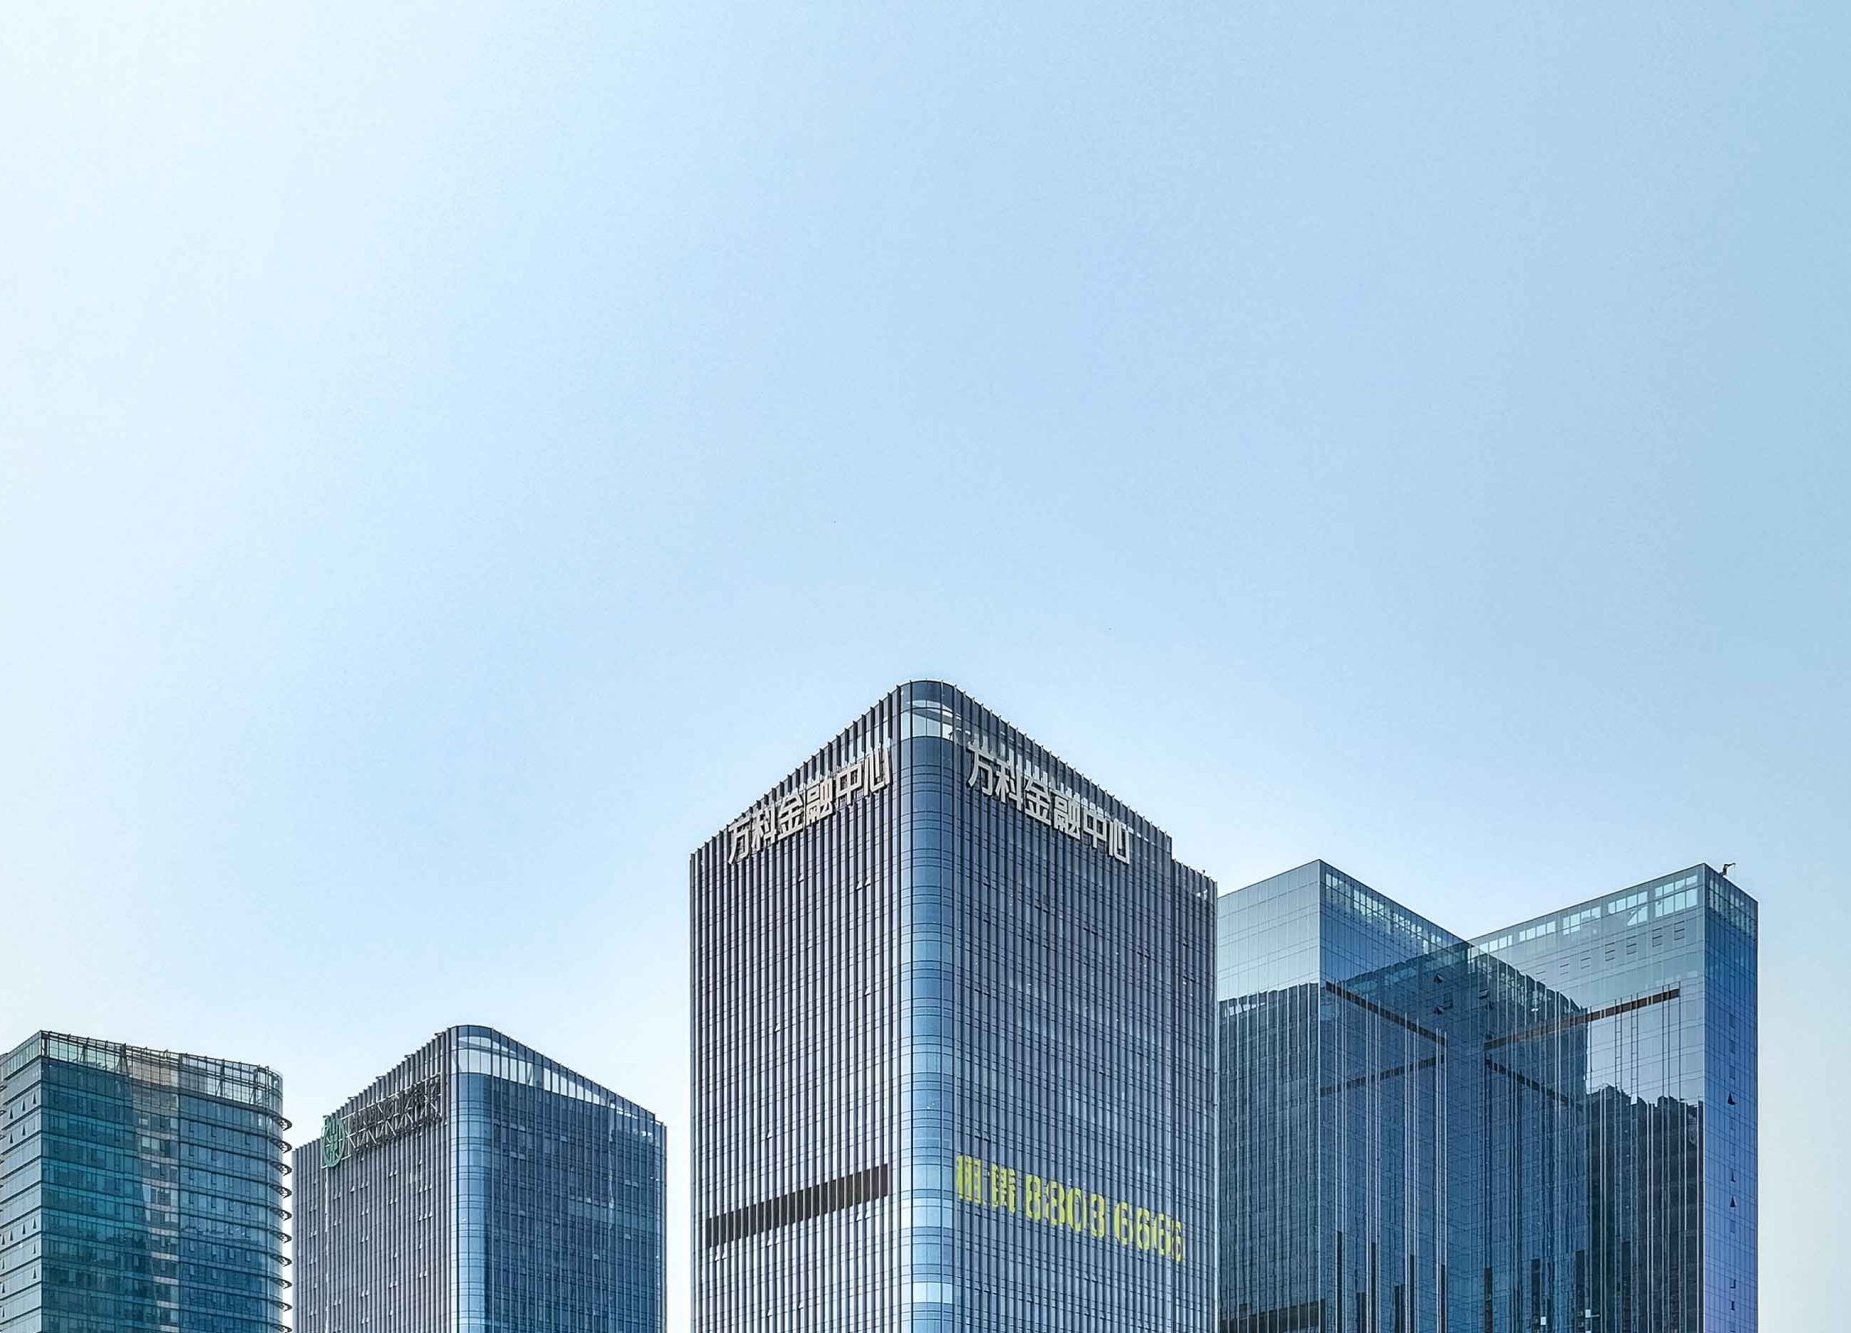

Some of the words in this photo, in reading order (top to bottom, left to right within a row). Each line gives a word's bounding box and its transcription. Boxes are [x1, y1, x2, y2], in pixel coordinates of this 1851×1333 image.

[727, 751, 892, 865] 万科金融中心
[967, 743, 1130, 864] 万科金融中心
